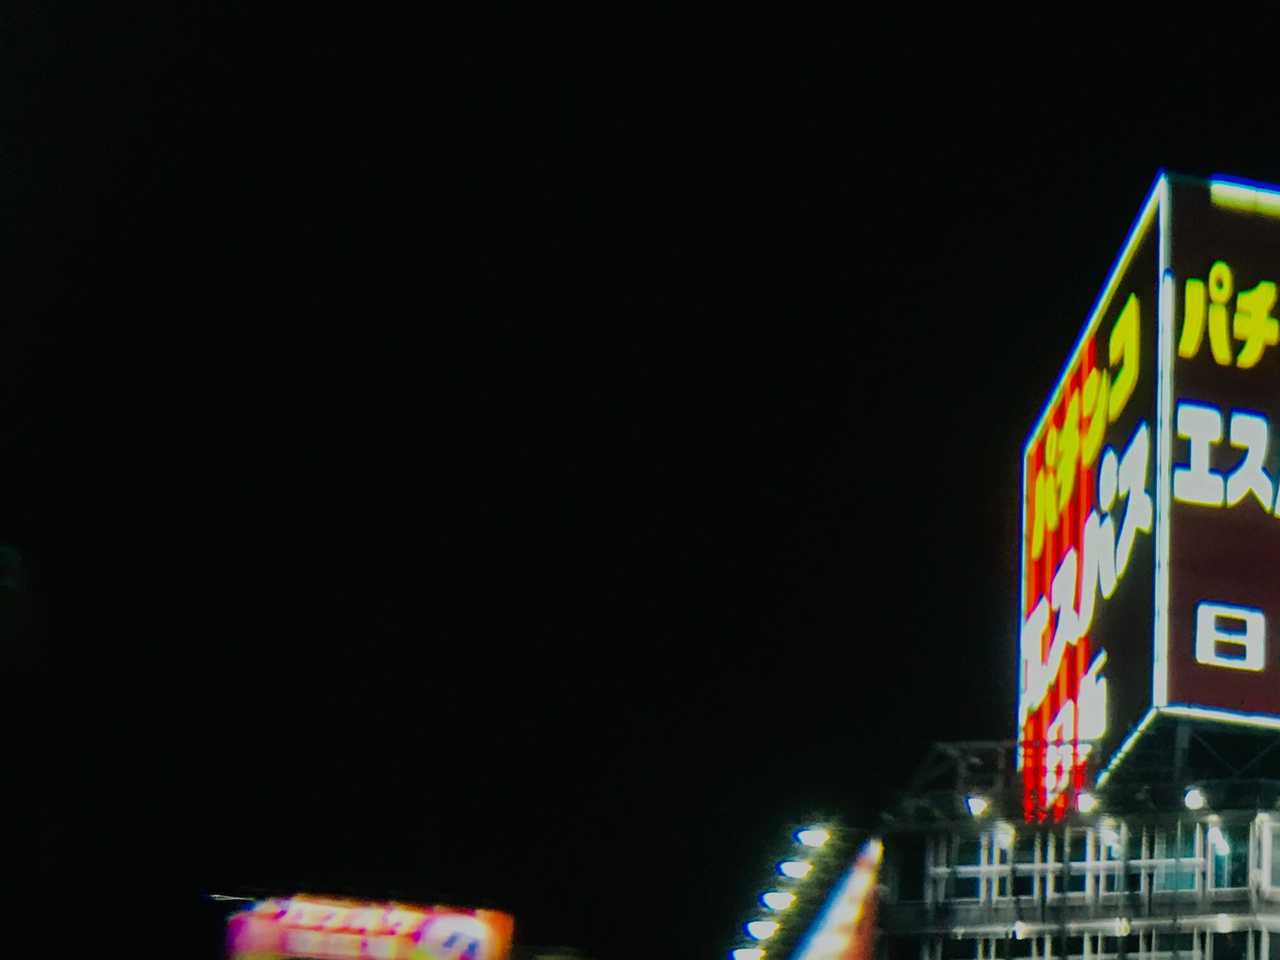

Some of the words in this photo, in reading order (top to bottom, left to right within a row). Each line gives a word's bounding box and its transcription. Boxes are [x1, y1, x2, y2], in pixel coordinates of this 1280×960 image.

[1020, 416, 1154, 714] エスパス
[1030, 291, 1140, 562] パチンコ
